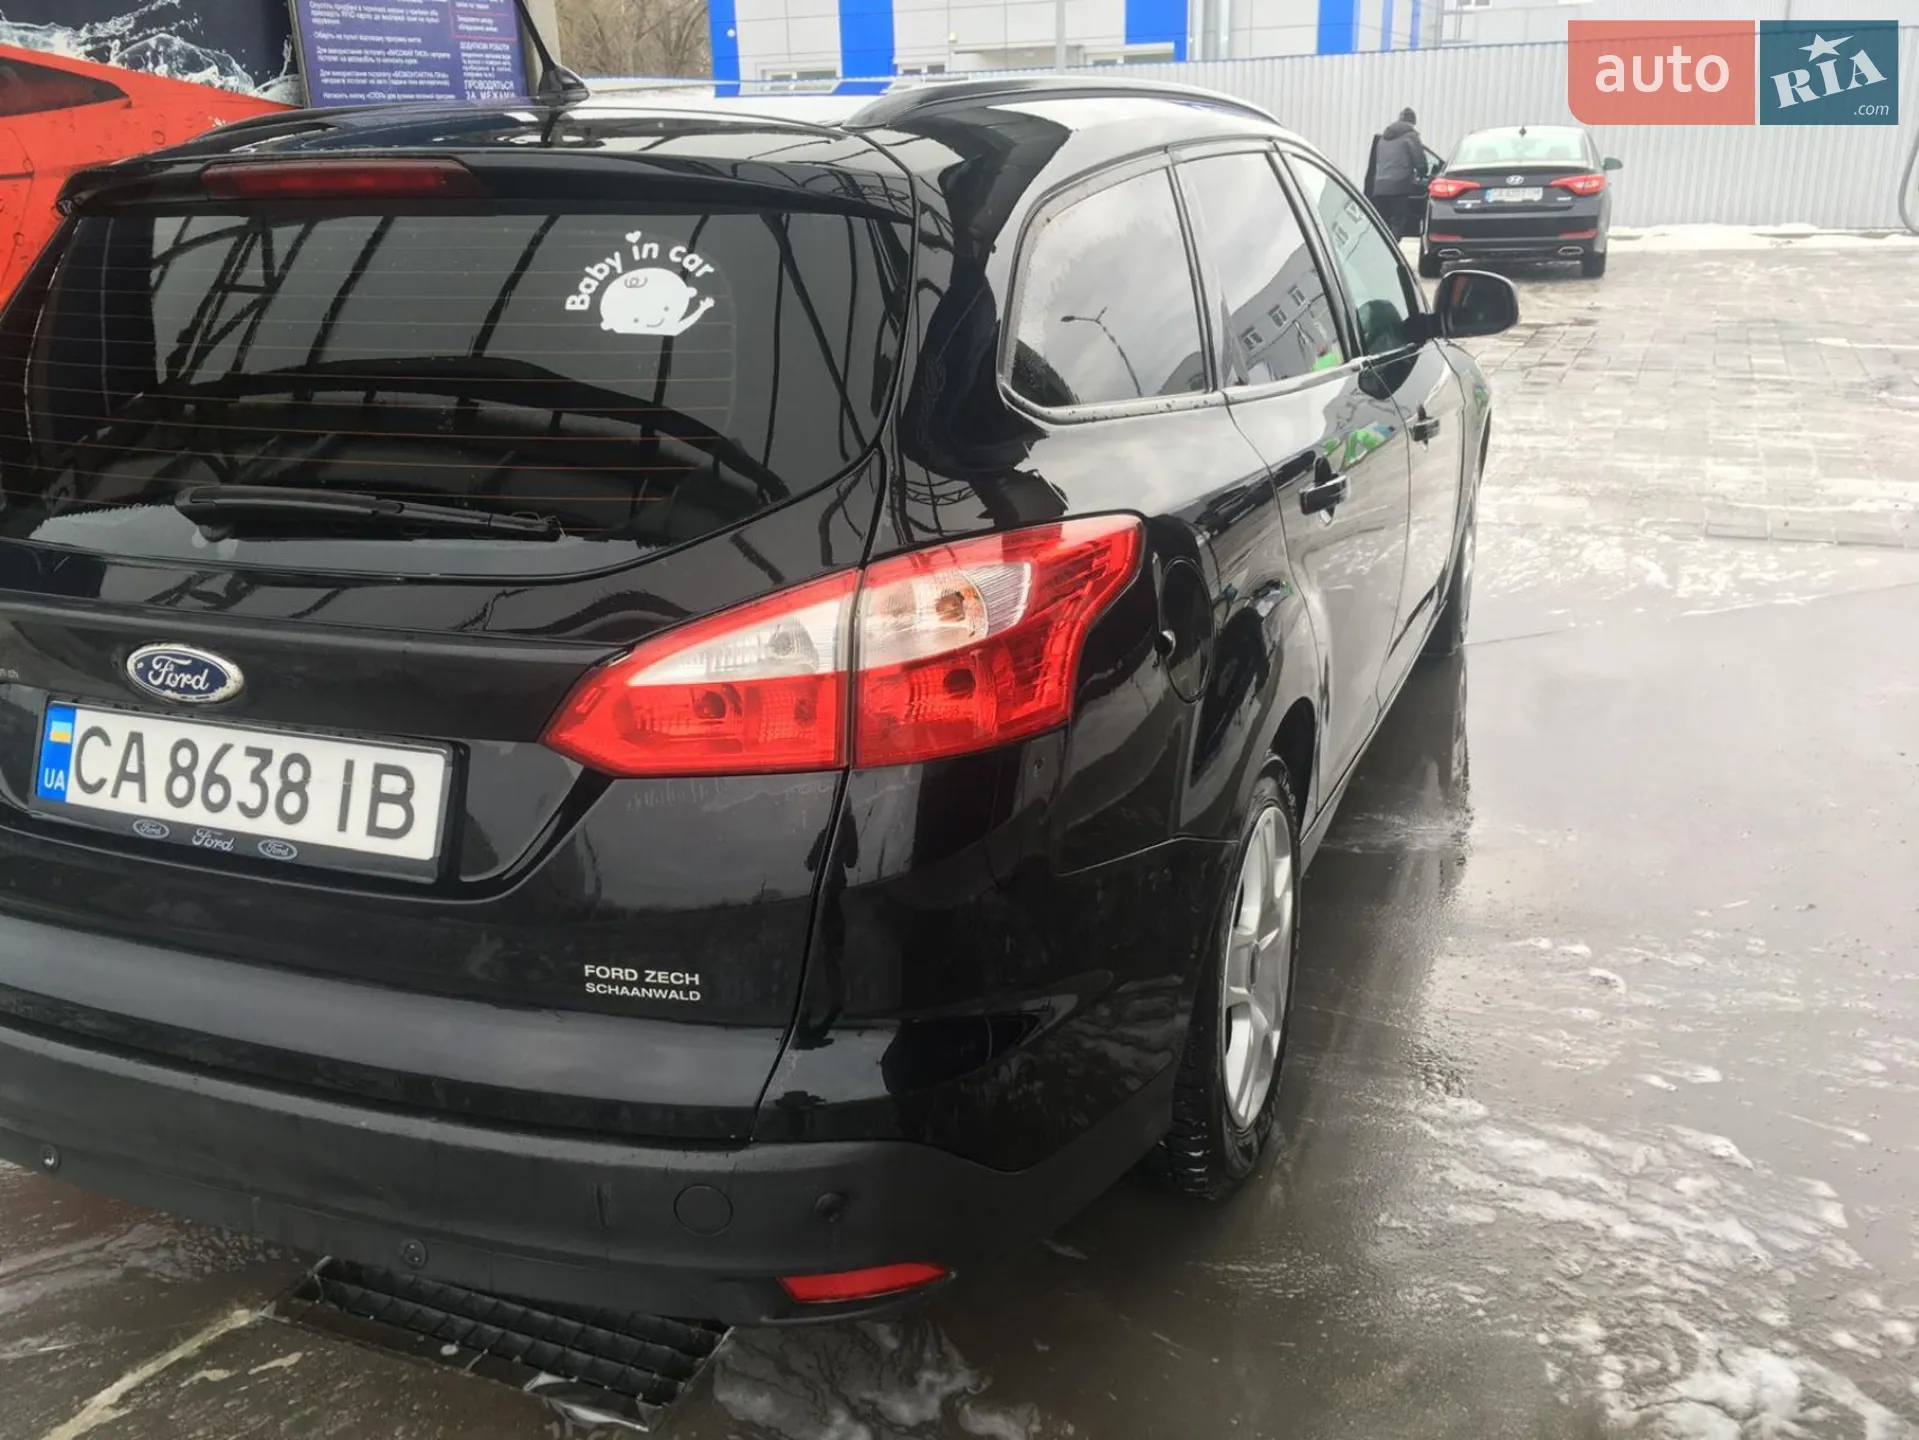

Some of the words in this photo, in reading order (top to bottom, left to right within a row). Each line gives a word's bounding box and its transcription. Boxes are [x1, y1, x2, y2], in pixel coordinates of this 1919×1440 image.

[565, 251, 623, 310] Baby
[668, 245, 715, 277] car
[147, 654, 210, 692] Ford
[43, 767, 65, 792] UA
[74, 725, 148, 804] CA
[165, 738, 311, 826] 8638
[337, 758, 416, 840] IB
[190, 828, 235, 852] Ford
[584, 964, 638, 981] FORD
[644, 970, 700, 985] ZECH
[585, 982, 702, 1001] SCHAANWALD
